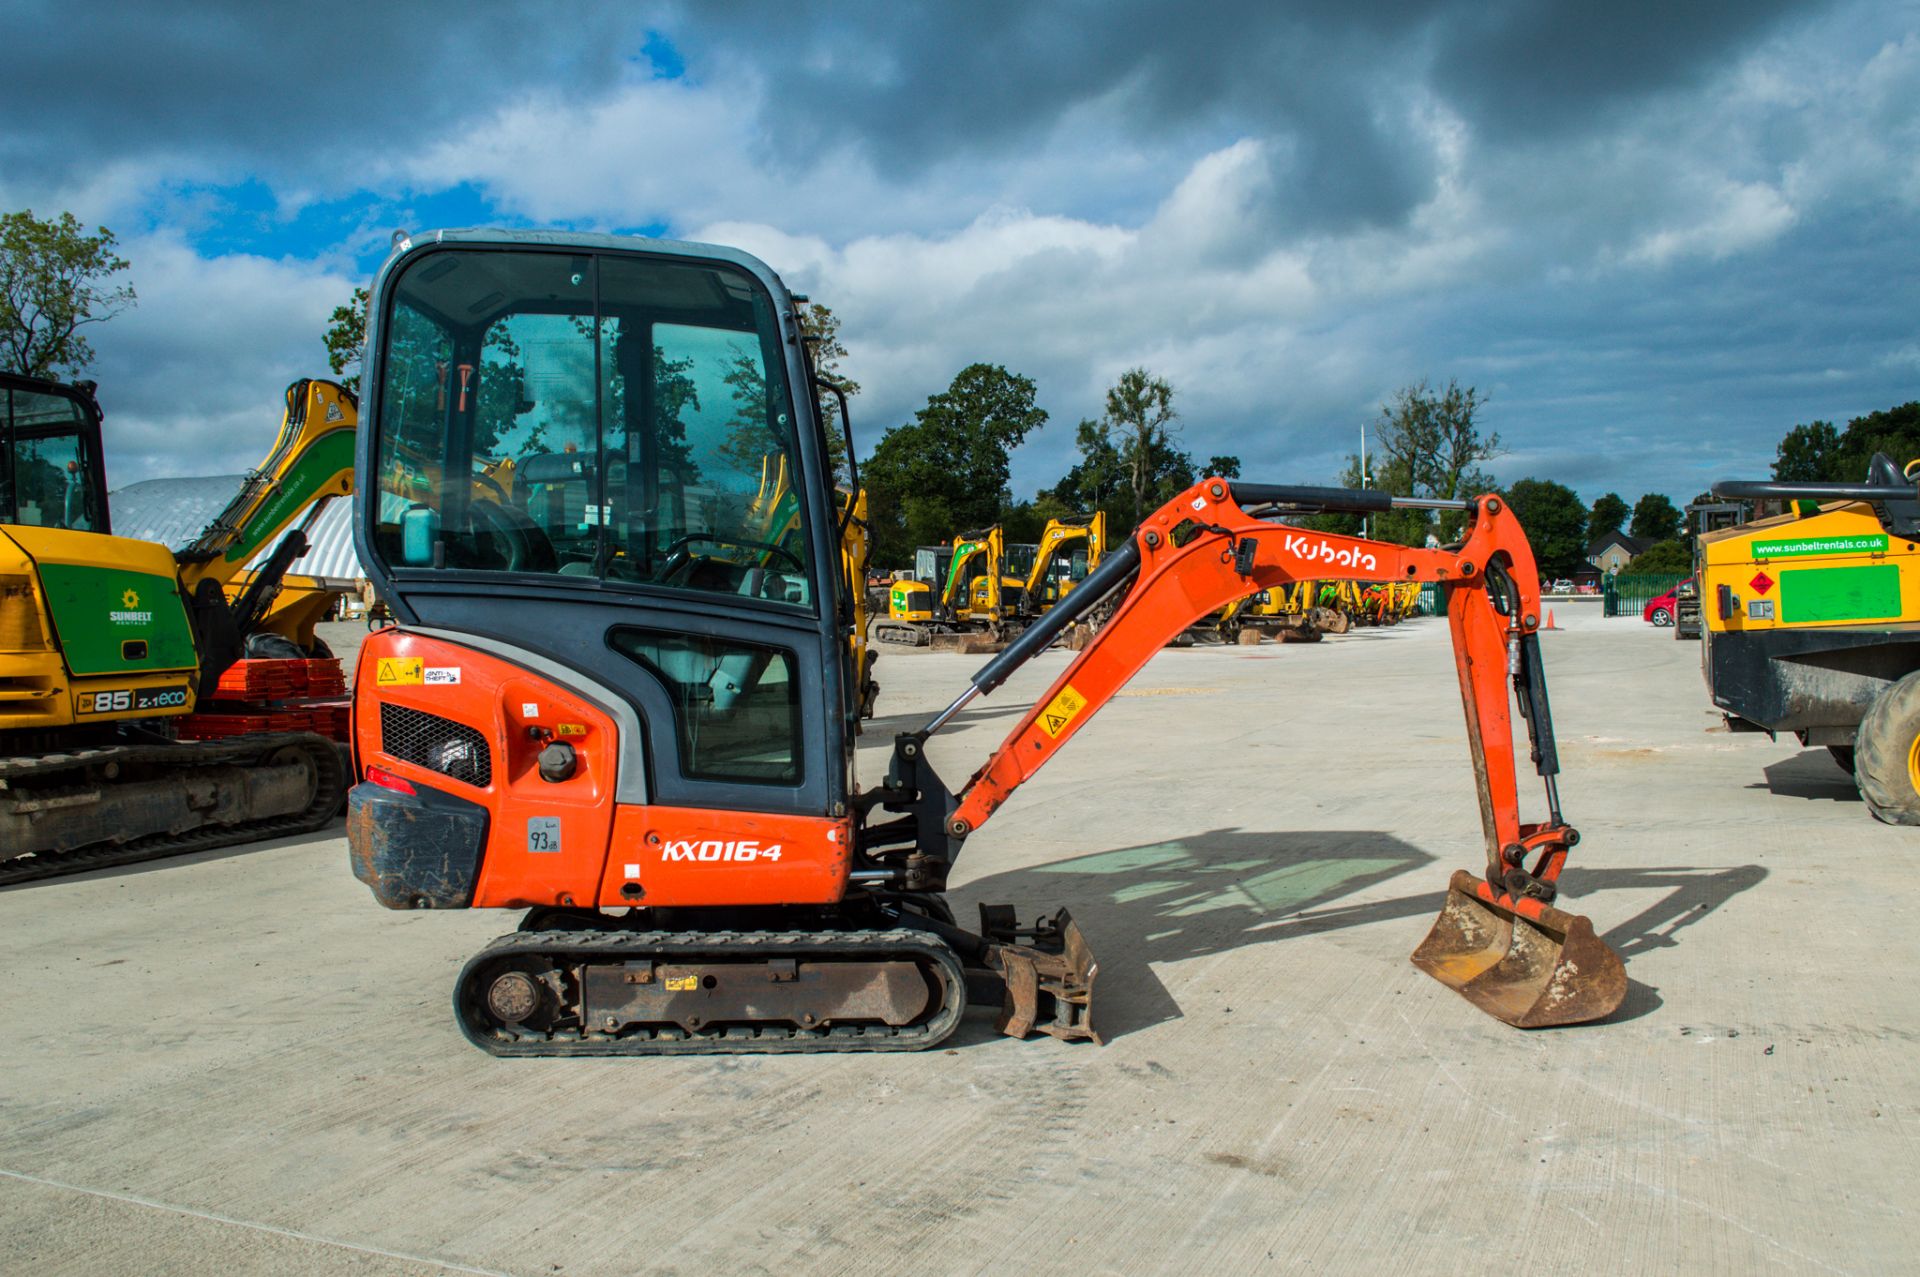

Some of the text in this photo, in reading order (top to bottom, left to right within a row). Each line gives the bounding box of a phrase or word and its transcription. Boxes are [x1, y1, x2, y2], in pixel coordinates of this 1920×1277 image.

[1284, 534, 1376, 571] Kubota
[1756, 538, 1882, 554] www.sunbeltrentals.co.uk
[109, 611, 152, 622] SUNBELT
[95, 692, 130, 712] 85
[531, 832, 548, 850] 93
